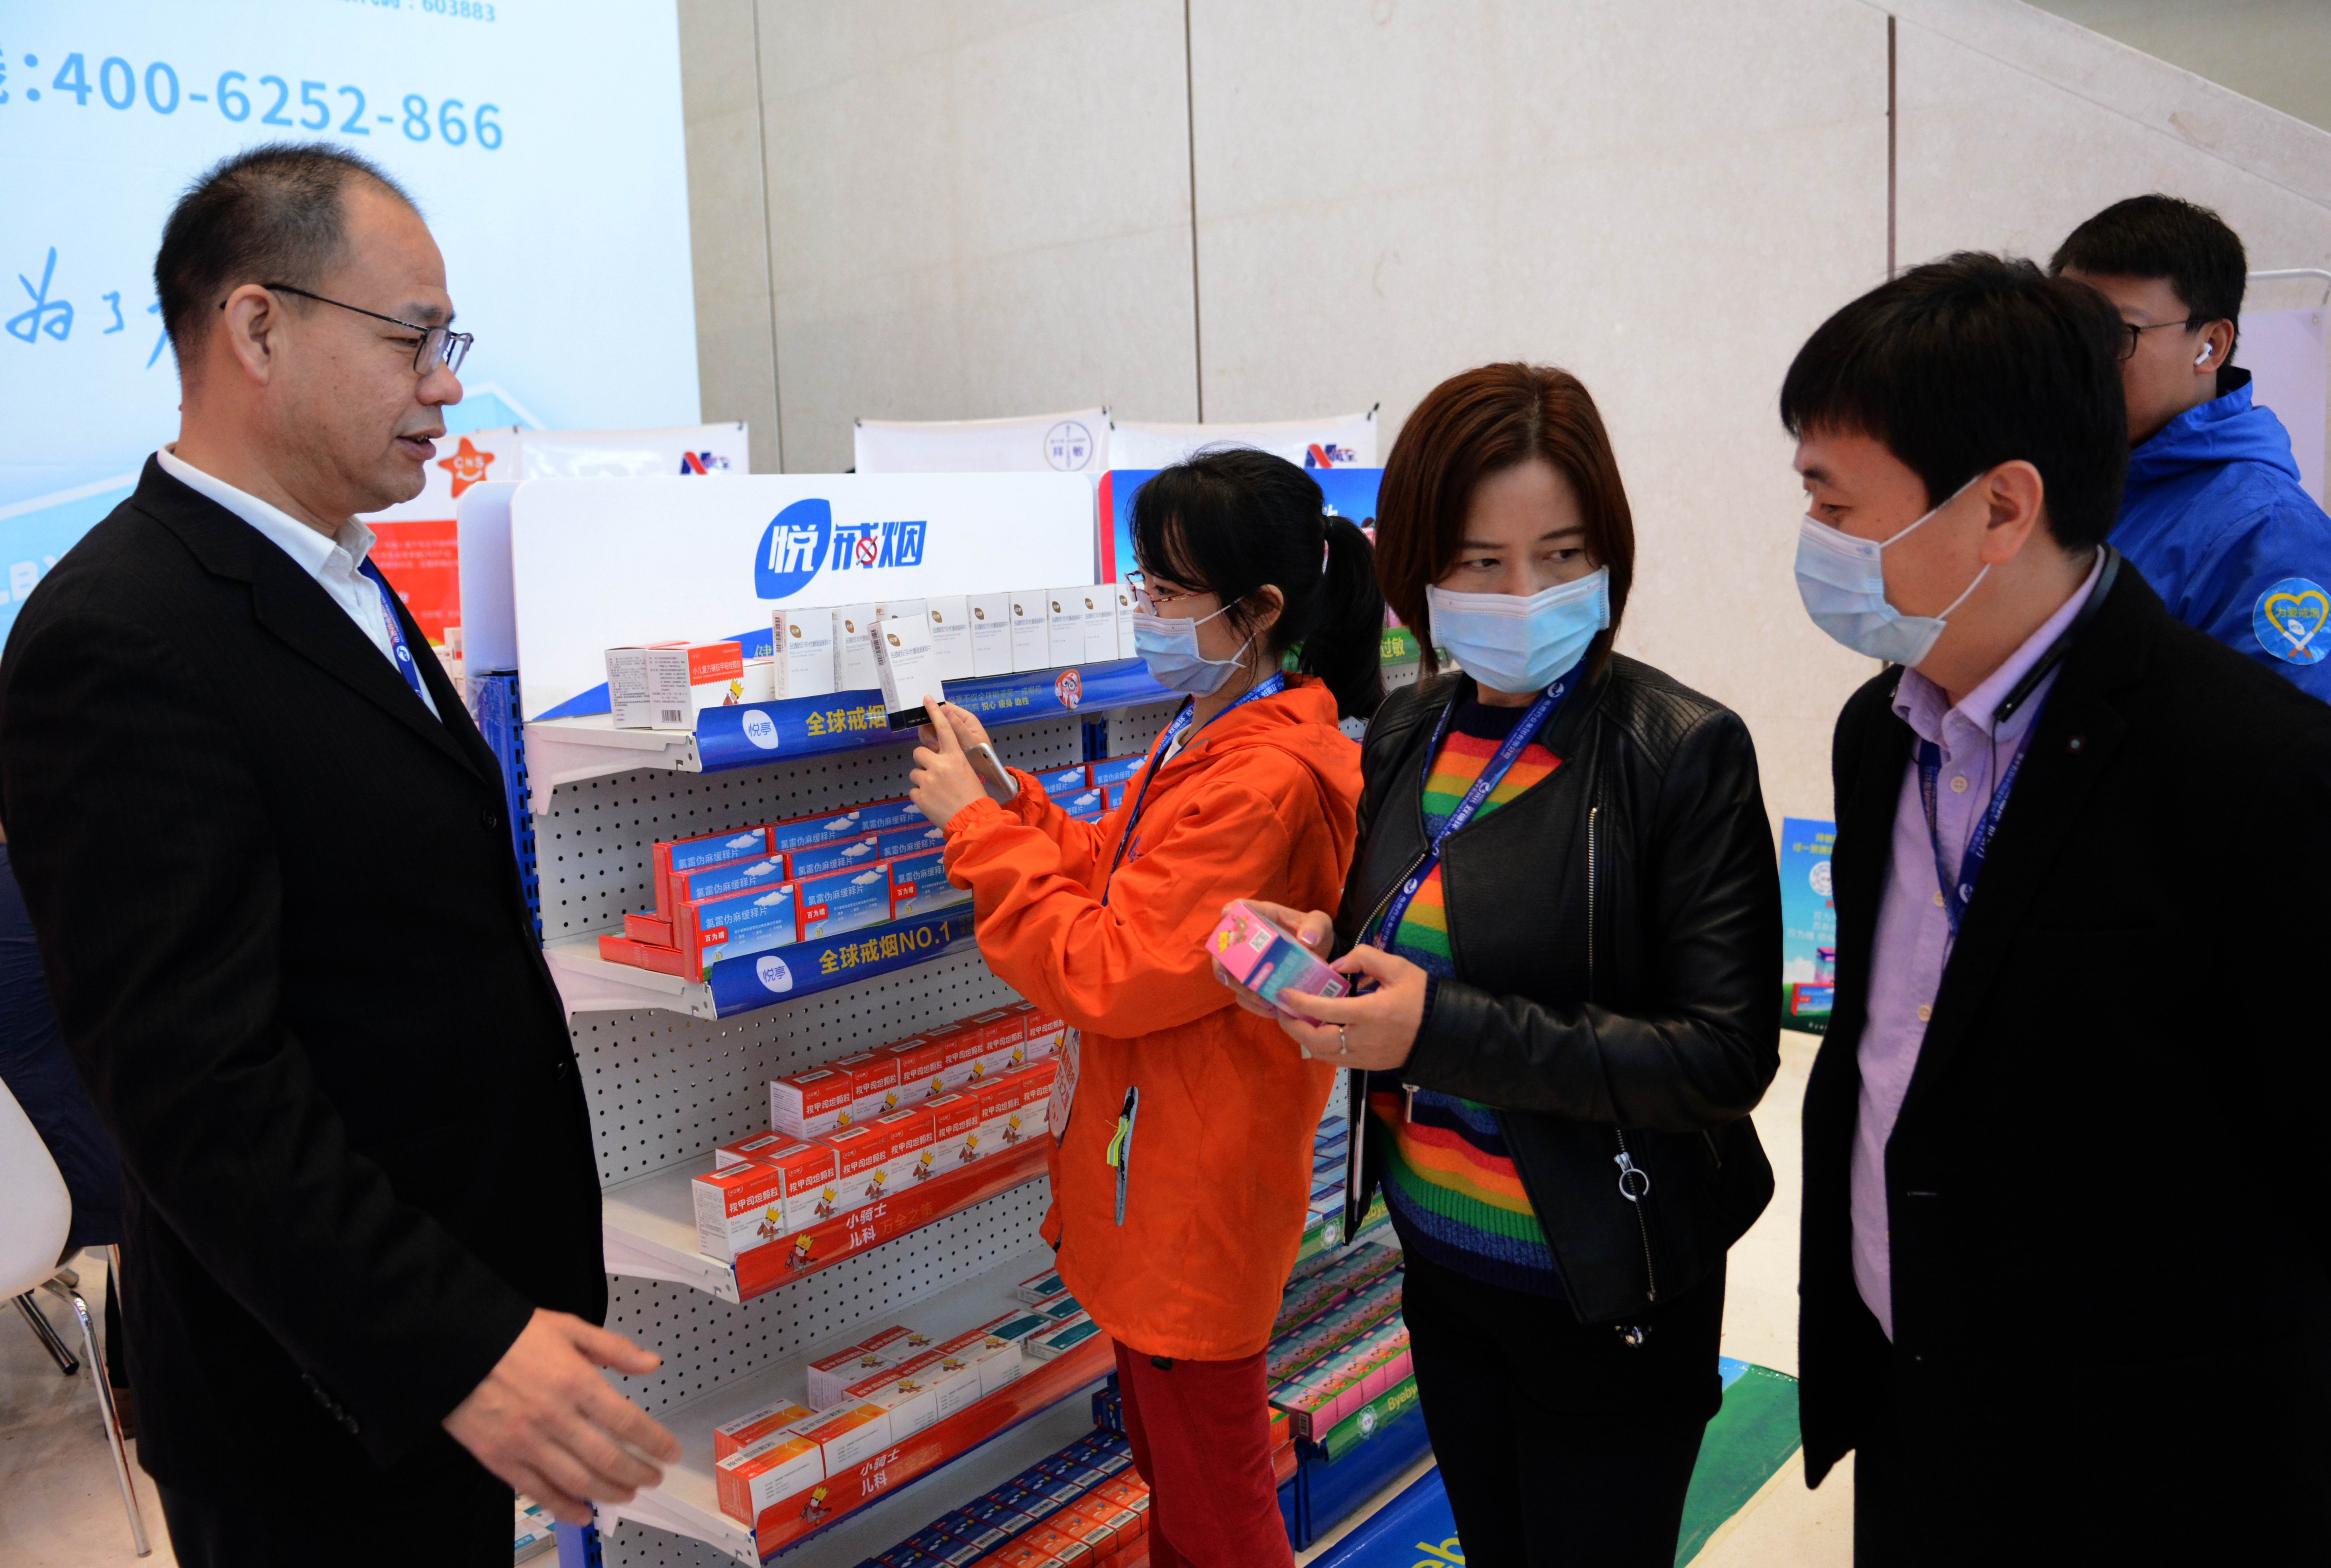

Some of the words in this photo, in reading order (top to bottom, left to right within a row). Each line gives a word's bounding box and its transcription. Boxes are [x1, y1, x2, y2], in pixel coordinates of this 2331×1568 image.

[422, 0, 496, 23] 603883
[748, 721, 771, 737] 悦亭
[806, 704, 887, 736] 全球戒烟
[678, 847, 739, 869] 氯雷伪麻缓释片
[696, 875, 757, 899] 氯雷伪麻缓释片
[808, 884, 864, 906] 氯雷伪麻缓释片
[706, 906, 767, 929] 氯雷伪麻缓释片
[818, 921, 950, 975] 全球戒烟NO.1
[763, 965, 786, 982] 悦亭
[855, 1074, 897, 1096] 羧甲司坦颗粒
[806, 1092, 851, 1115] 羧甲司坦颗粒
[890, 1132, 933, 1155] 羧甲司坦颗粒
[843, 1151, 887, 1175] 羧甲司坦颗粒
[789, 1164, 835, 1193] 羧甲司坦颗粒
[729, 1187, 779, 1213] 羧甲司坦颗粒
[846, 1202, 887, 1229] 小骑士
[850, 1225, 876, 1250] 儿科
[860, 1448, 900, 1476] 小骑士
[862, 1470, 887, 1496] 儿科
